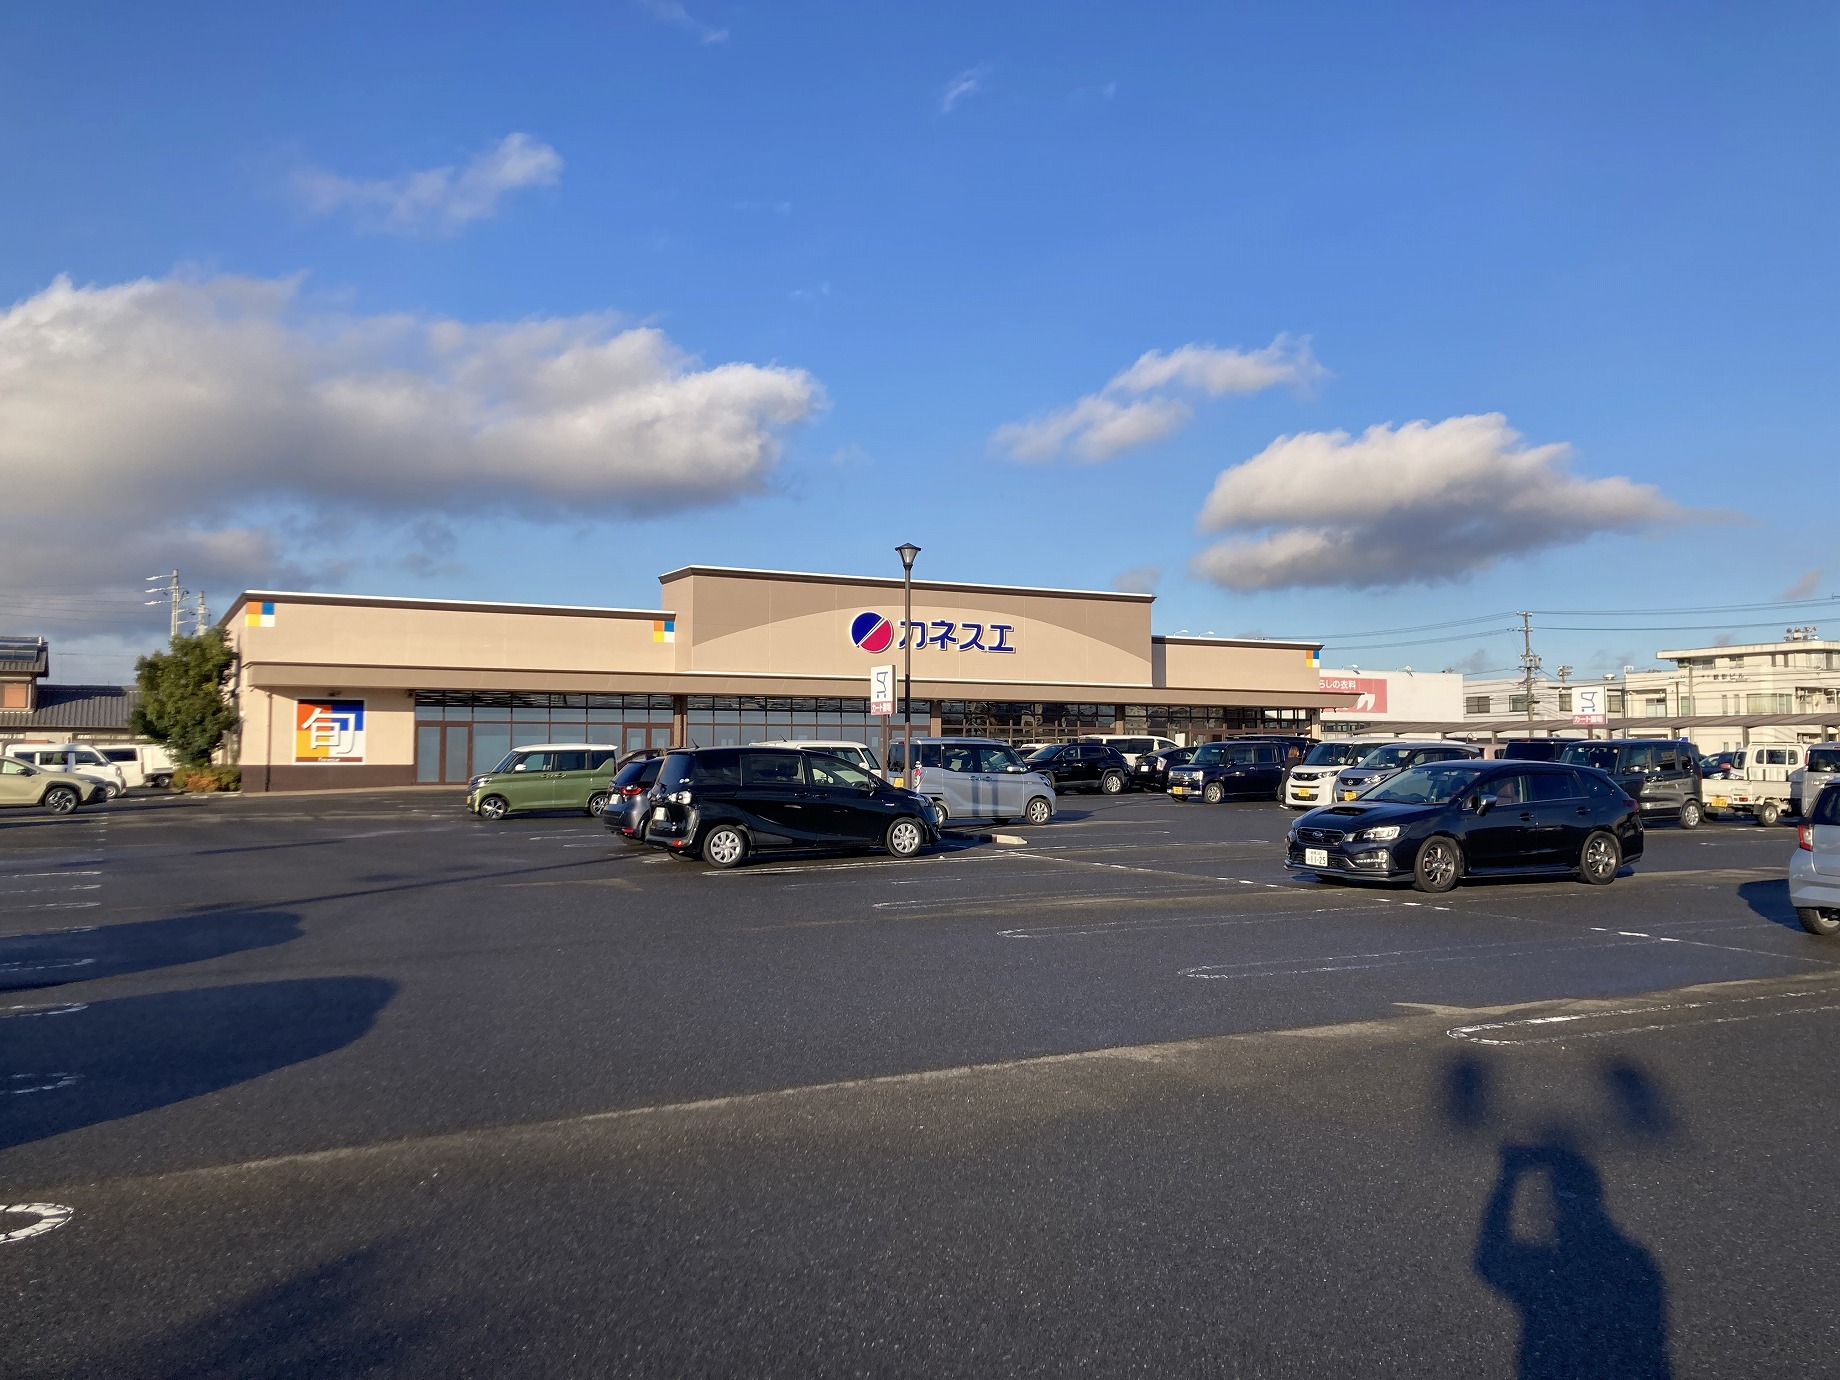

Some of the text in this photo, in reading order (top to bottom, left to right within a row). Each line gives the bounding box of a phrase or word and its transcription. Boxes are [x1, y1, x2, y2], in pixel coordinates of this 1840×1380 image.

[898, 620, 1015, 653] カネスエ
[301, 707, 356, 754] 旬
